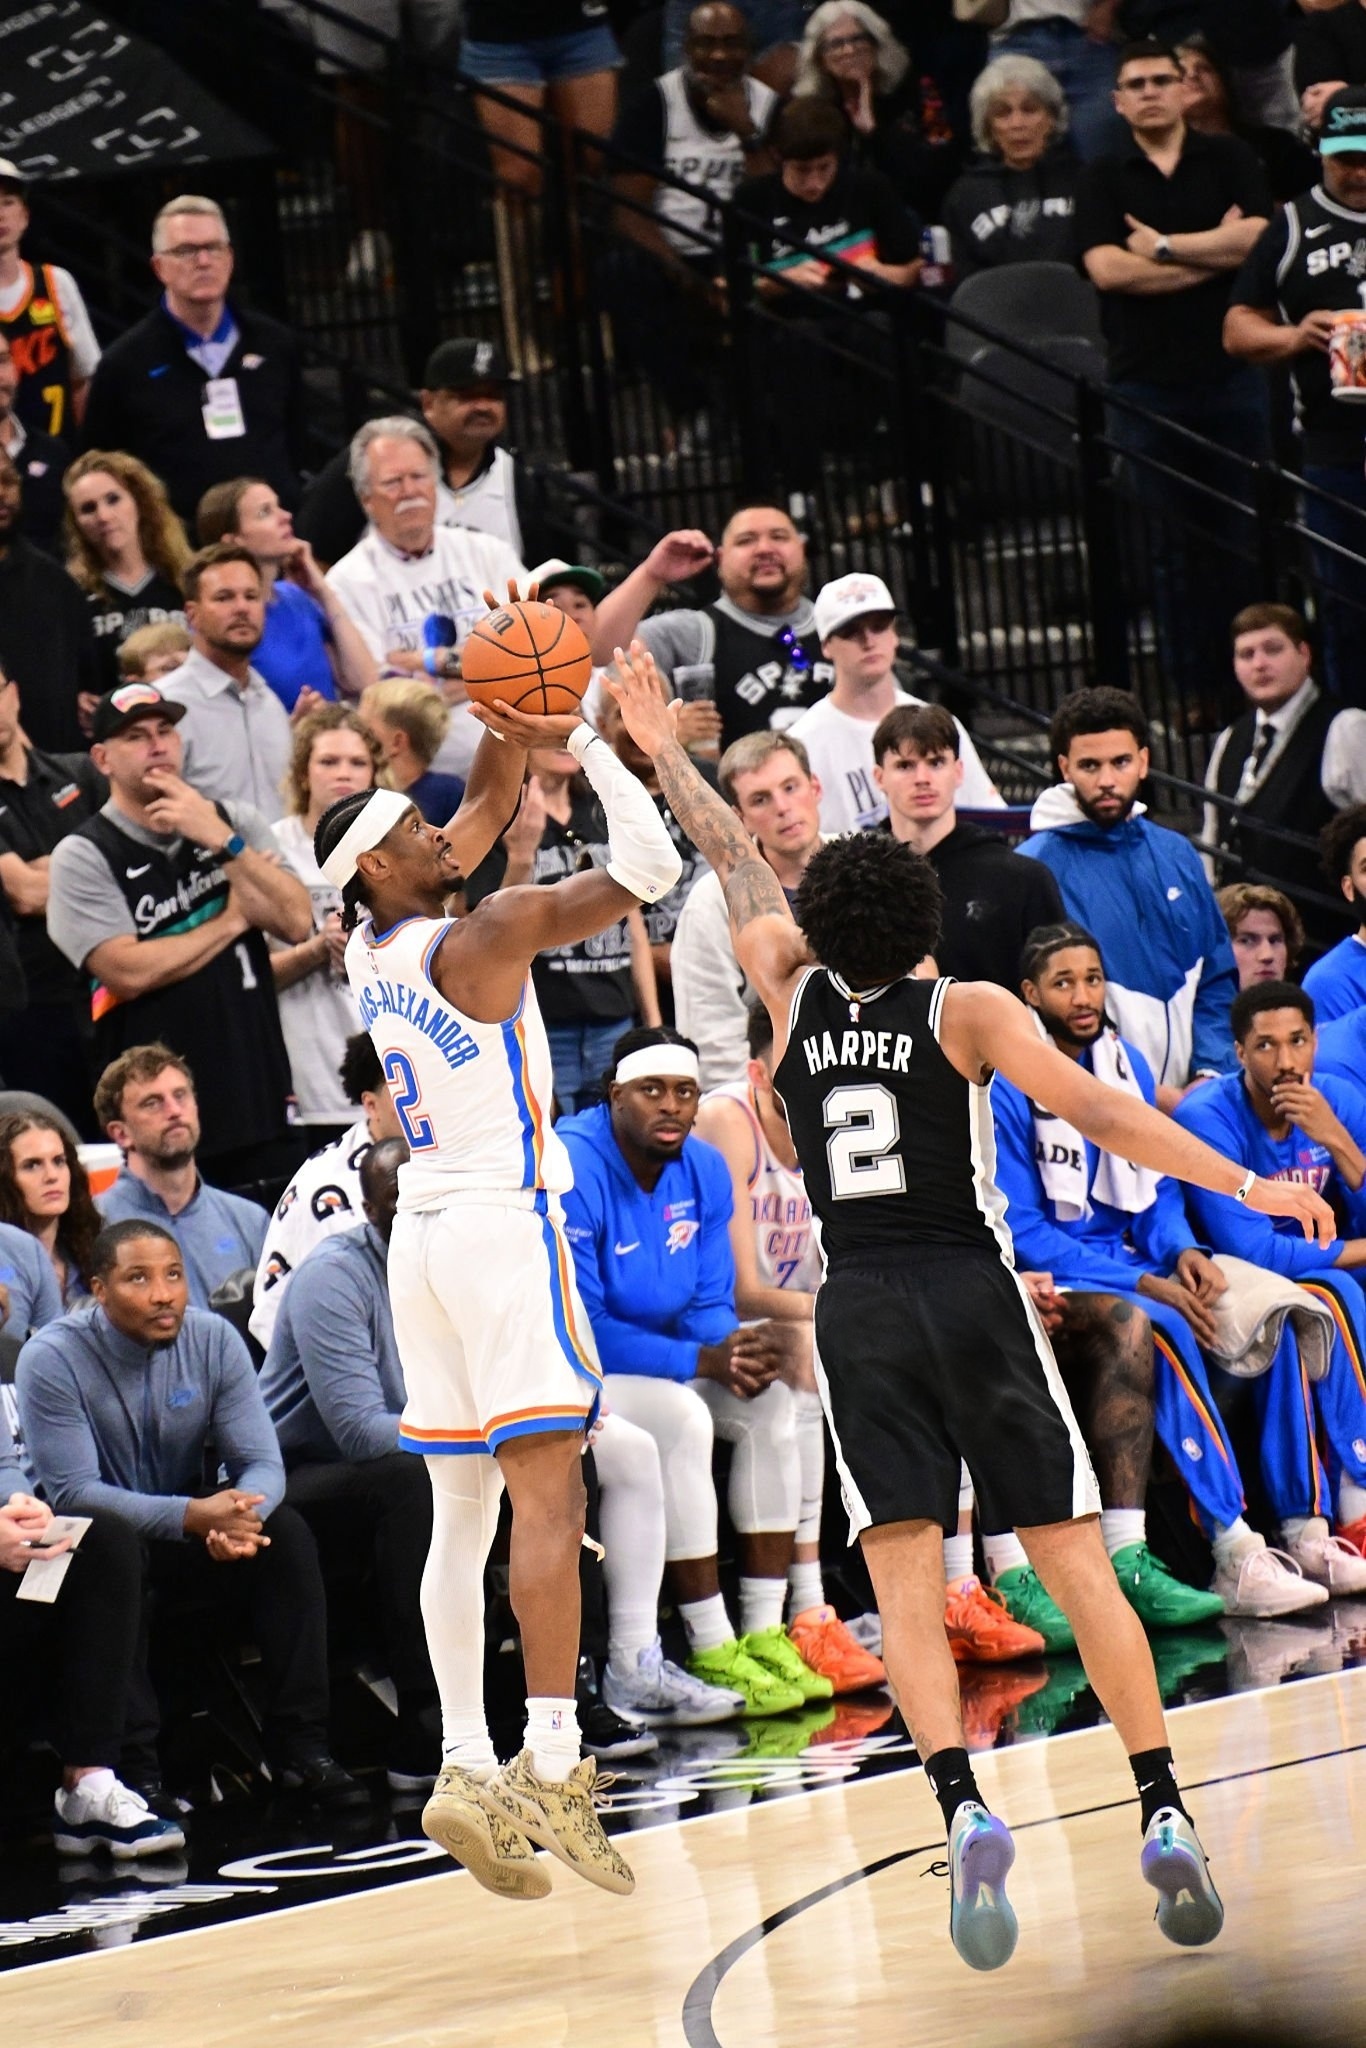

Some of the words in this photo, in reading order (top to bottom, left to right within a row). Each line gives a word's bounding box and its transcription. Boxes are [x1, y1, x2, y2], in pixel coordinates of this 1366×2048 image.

[42, 384, 64, 436] 7
[234, 943, 257, 989] 1
[803, 1030, 912, 1076] HARPER
[382, 1047, 438, 1153] 2
[822, 1083, 907, 1201] 2
[766, 1231, 804, 1256] CIT
[776, 1259, 800, 1289] 7
